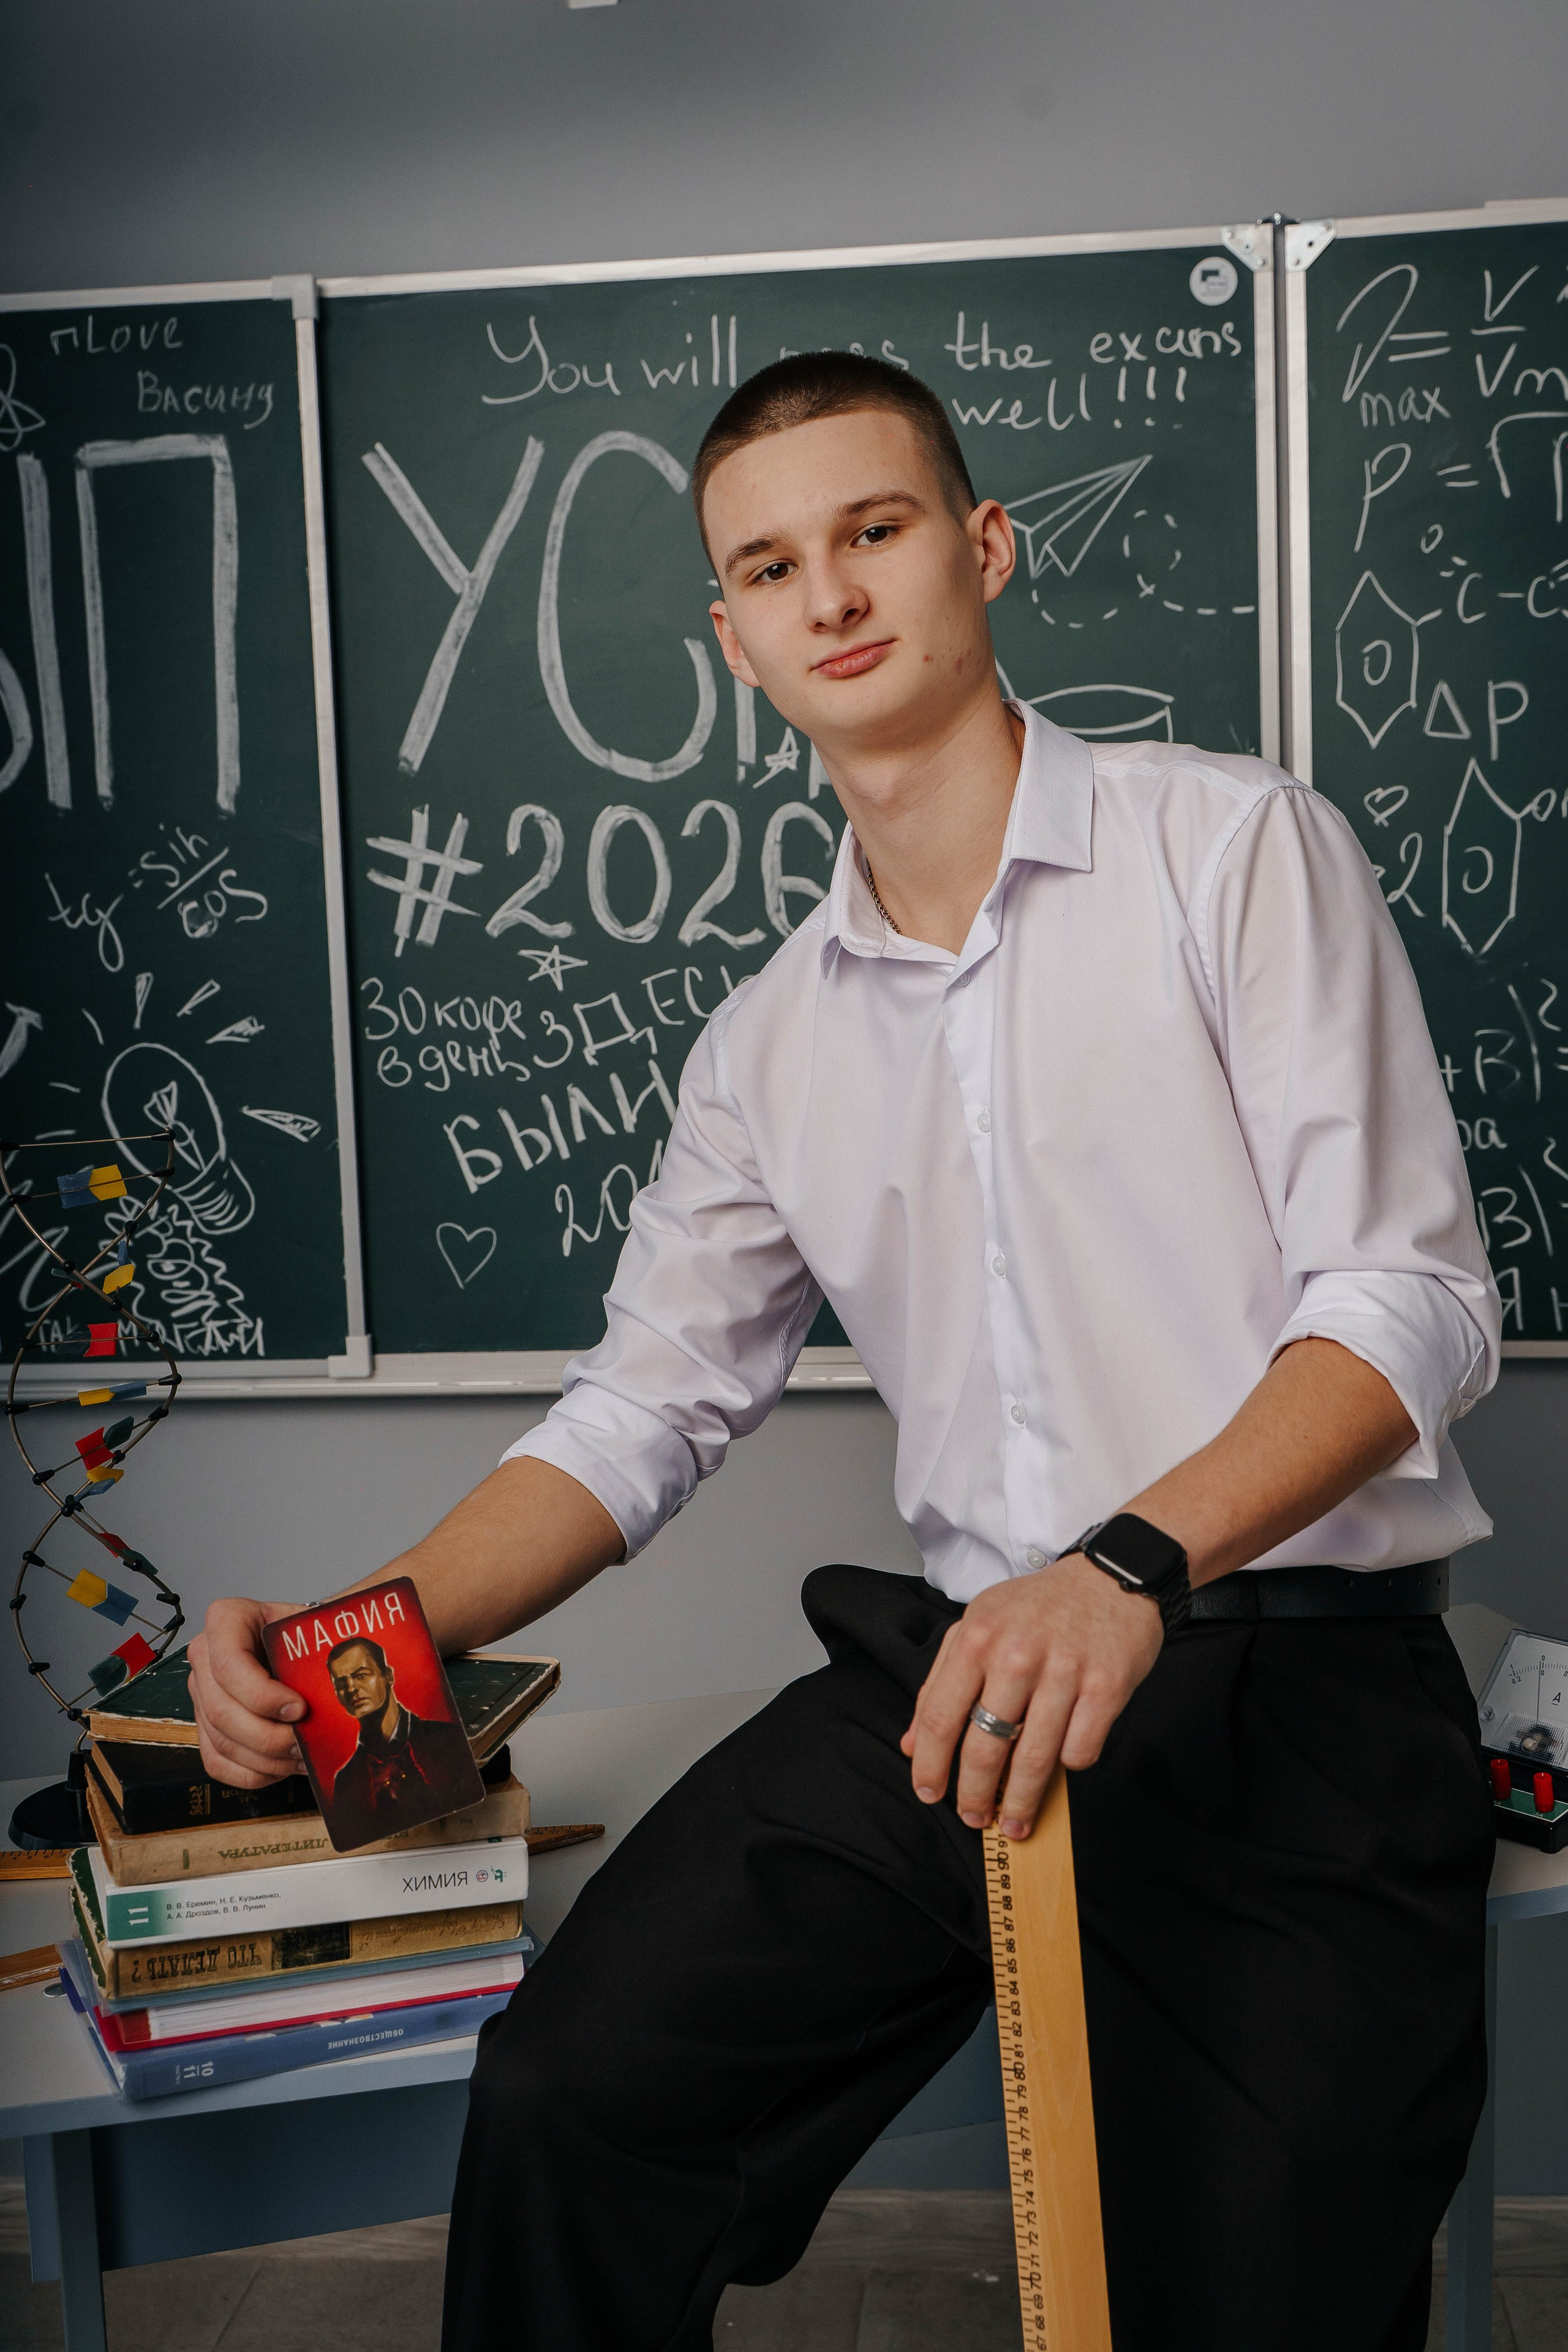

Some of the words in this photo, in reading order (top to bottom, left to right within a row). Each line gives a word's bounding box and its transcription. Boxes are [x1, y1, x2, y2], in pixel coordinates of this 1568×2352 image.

[481, 315, 621, 404] You
[640, 314, 737, 389] will
[944, 310, 1052, 371] the
[1090, 320, 1242, 360] exams
[1359, 386, 1452, 428] max
[366, 800, 835, 957] #2026
[443, 1059, 676, 1194] БЫЛИ
[282, 1592, 405, 1662] МАФИЯ
[998, 1833, 1008, 1848] 91
[217, 1838, 329, 1860] ЛИТЕРАТУРА
[997, 1852, 1009, 1871] 90
[402, 1871, 468, 1893] ХИМИЯ
[1001, 1874, 1011, 1890] 89
[186, 1899, 217, 1909] Еремин,
[239, 1893, 281, 1903] Кузьменко,
[1002, 1895, 1012, 1911] 88
[185, 1909, 221, 1919] Дроздов,
[243, 1904, 266, 1912] Лунин
[1004, 1916, 1014, 1931] 87
[1006, 1938, 1016, 1954] 86
[147, 1945, 221, 1980] ДЕЛАТЬ
[227, 1943, 262, 1968] ЧТО
[1007, 1958, 1017, 1973] 85
[1009, 1981, 1019, 1995] 84
[1011, 2000, 1020, 2016] 83
[1012, 2022, 1022, 2037] 82
[328, 2028, 404, 2049] ОБЩЕСТВОЗНАНИЕ
[1014, 2043, 1024, 2058] 81
[1014, 2062, 1026, 2081] 80
[1017, 2084, 1027, 2100] 79
[1019, 2106, 1028, 2121] 78
[1020, 2127, 1031, 2142] 77
[1022, 2148, 1032, 2162] 76
[1023, 2169, 1033, 2184] 75
[1025, 2191, 1035, 2205] 74
[1027, 2211, 1037, 2225] 73
[1028, 2231, 1038, 2247] 72
[1031, 2253, 1041, 2268] 71
[1030, 2271, 1042, 2290] 70
[1033, 2294, 1044, 2310] 69
[1035, 2315, 1045, 2331] 68
[1036, 2335, 1047, 2351] 67
